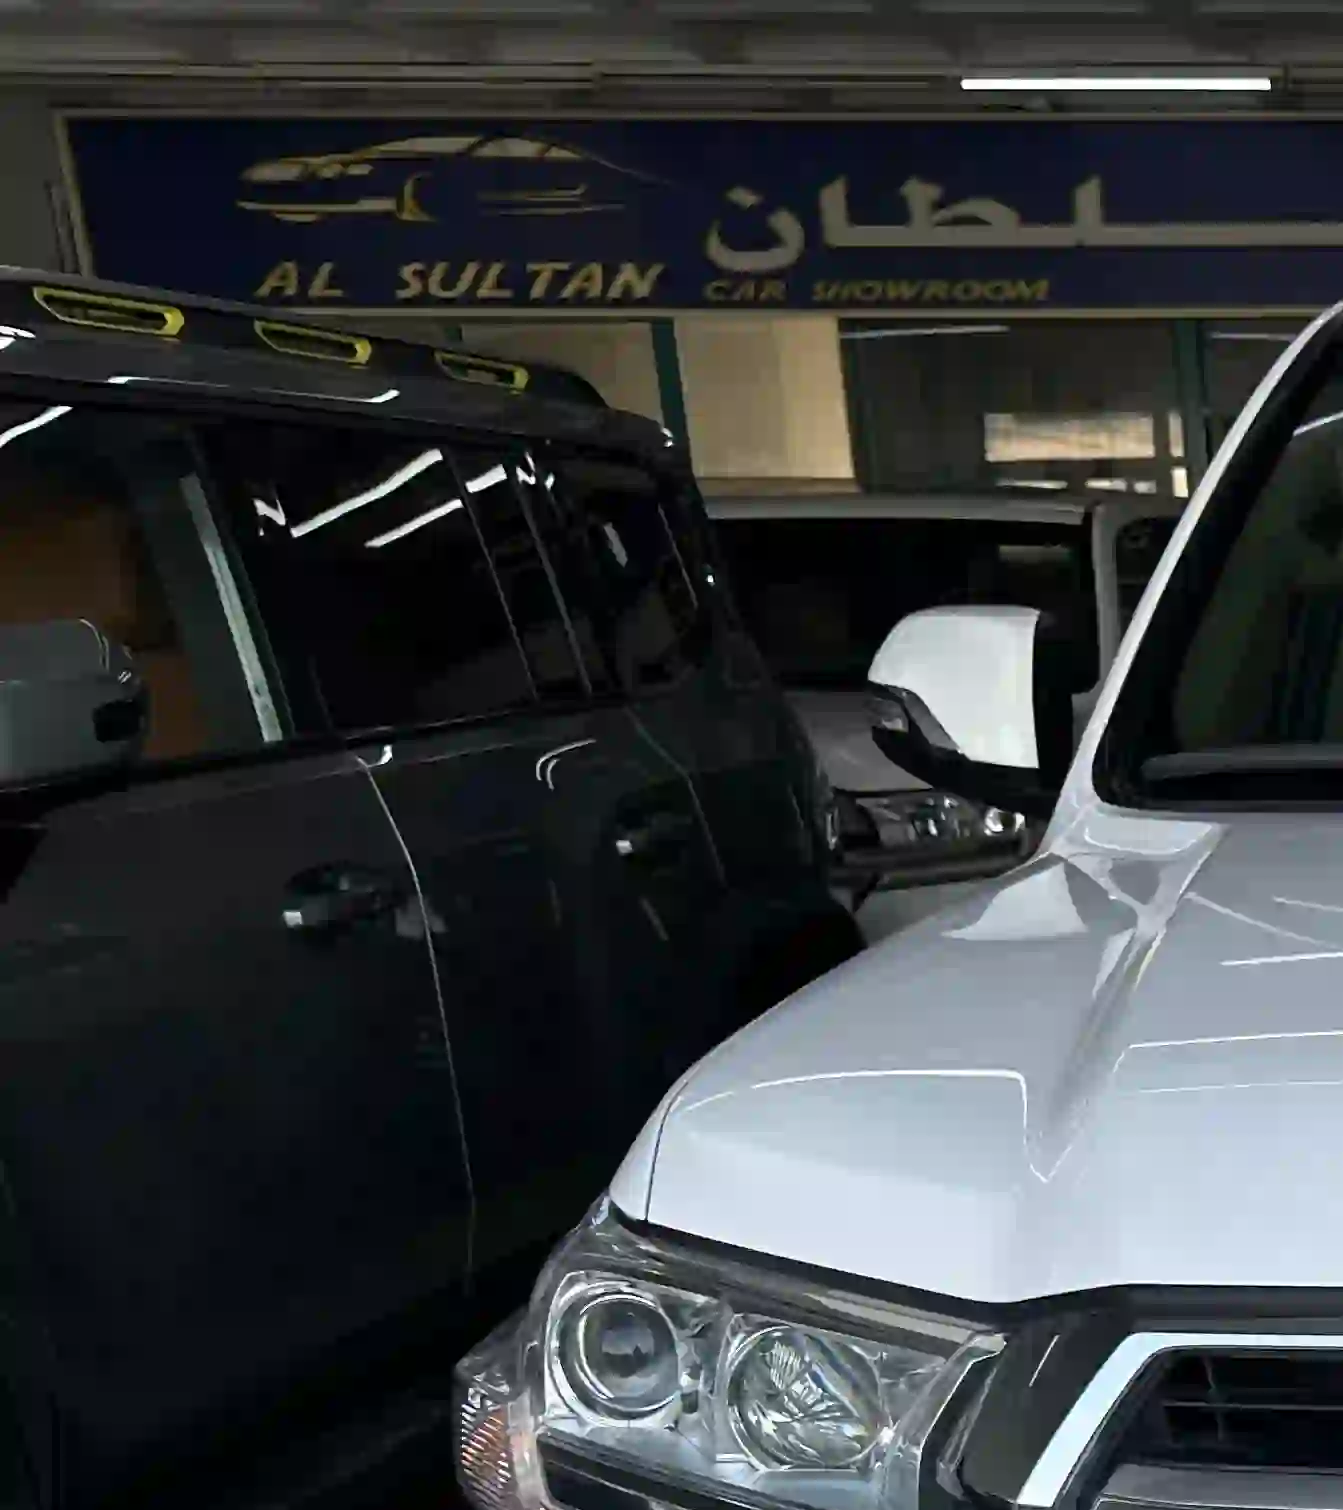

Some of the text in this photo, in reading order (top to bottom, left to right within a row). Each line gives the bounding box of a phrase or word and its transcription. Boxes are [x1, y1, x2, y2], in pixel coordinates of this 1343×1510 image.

[252, 259, 666, 300] AL SULTAN
[703, 277, 1050, 302] CAR SHOWROOM
